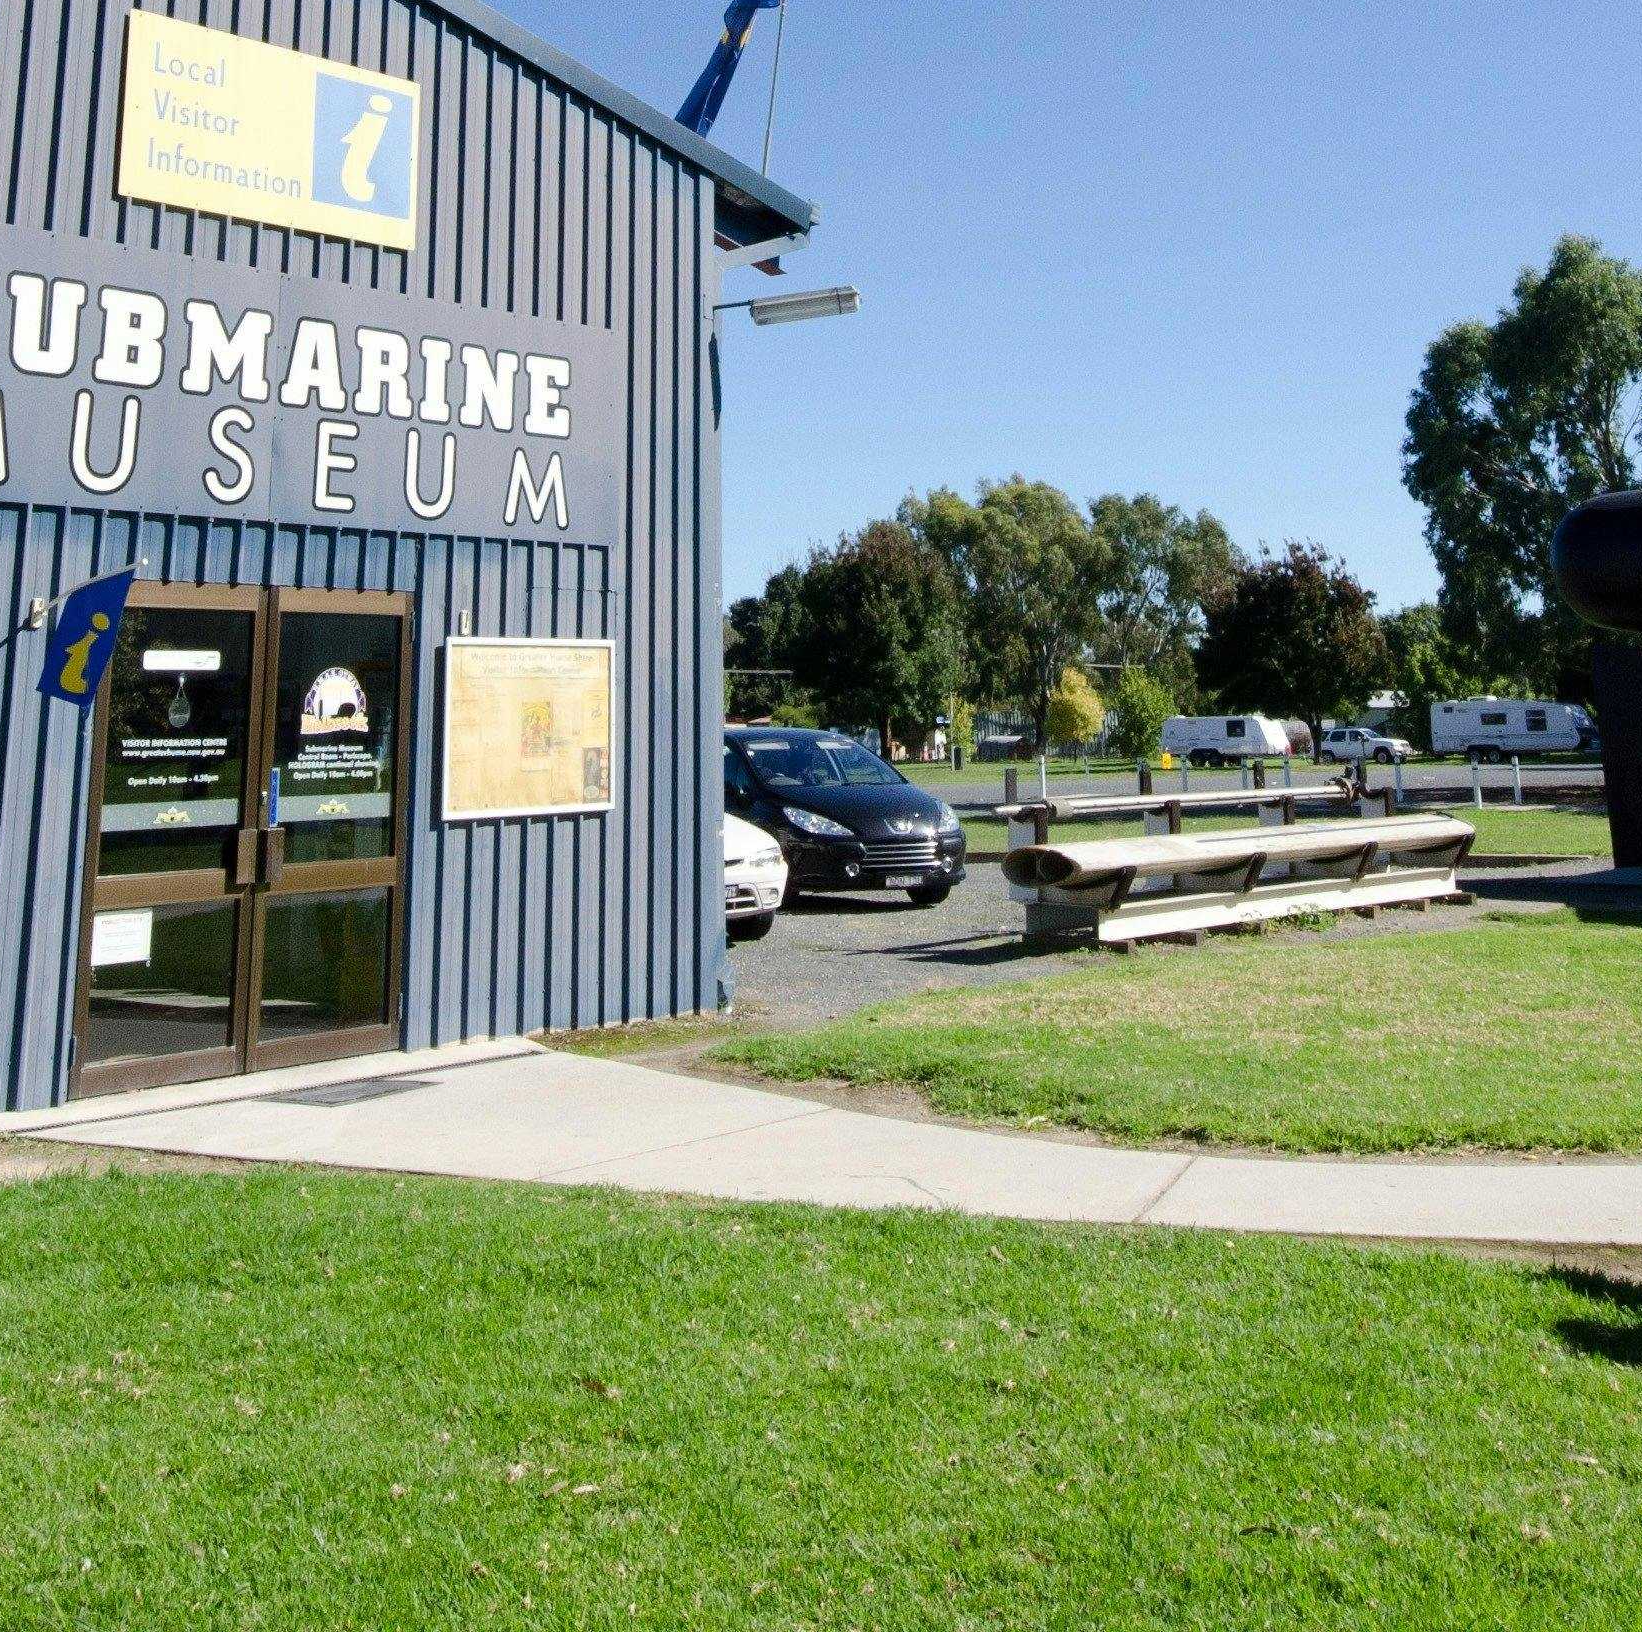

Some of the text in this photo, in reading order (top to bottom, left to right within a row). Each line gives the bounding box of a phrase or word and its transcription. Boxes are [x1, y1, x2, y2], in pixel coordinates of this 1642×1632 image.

[152, 40, 225, 88] Local
[152, 88, 240, 136] Visitor
[148, 137, 302, 198] Information
[121, 738, 228, 747] VISITOR INFORMATION CENTRE
[127, 777, 147, 787] Open
[148, 776, 167, 786] Daily
[293, 772, 311, 780] Open
[311, 771, 327, 780] Daily
